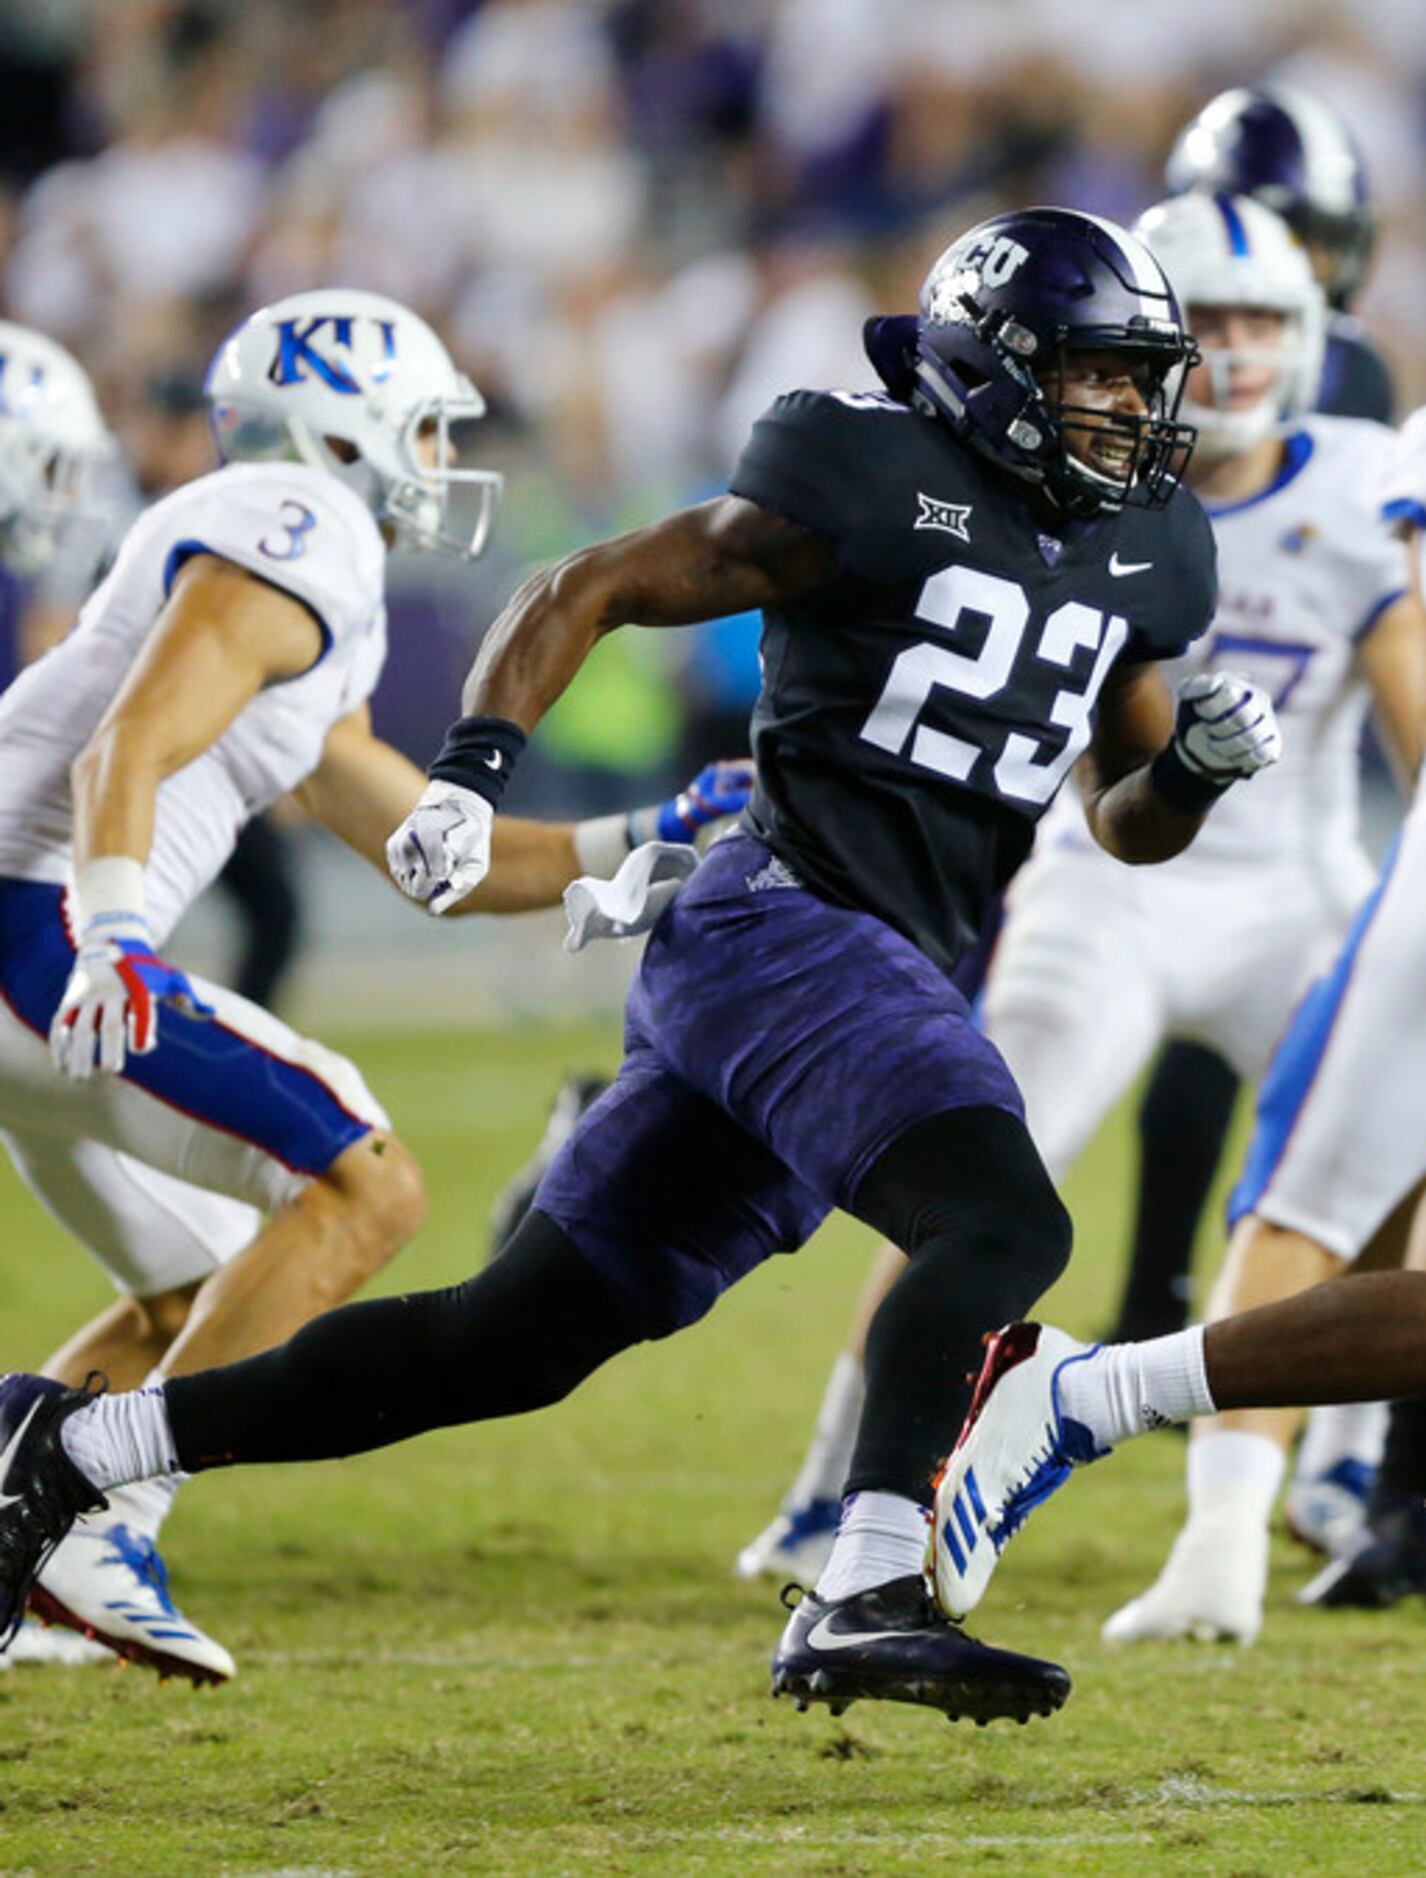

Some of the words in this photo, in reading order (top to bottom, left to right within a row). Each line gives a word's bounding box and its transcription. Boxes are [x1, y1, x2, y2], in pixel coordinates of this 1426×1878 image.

[267, 316, 396, 394] KU
[257, 499, 317, 561] 3
[860, 564, 1129, 804] 23
